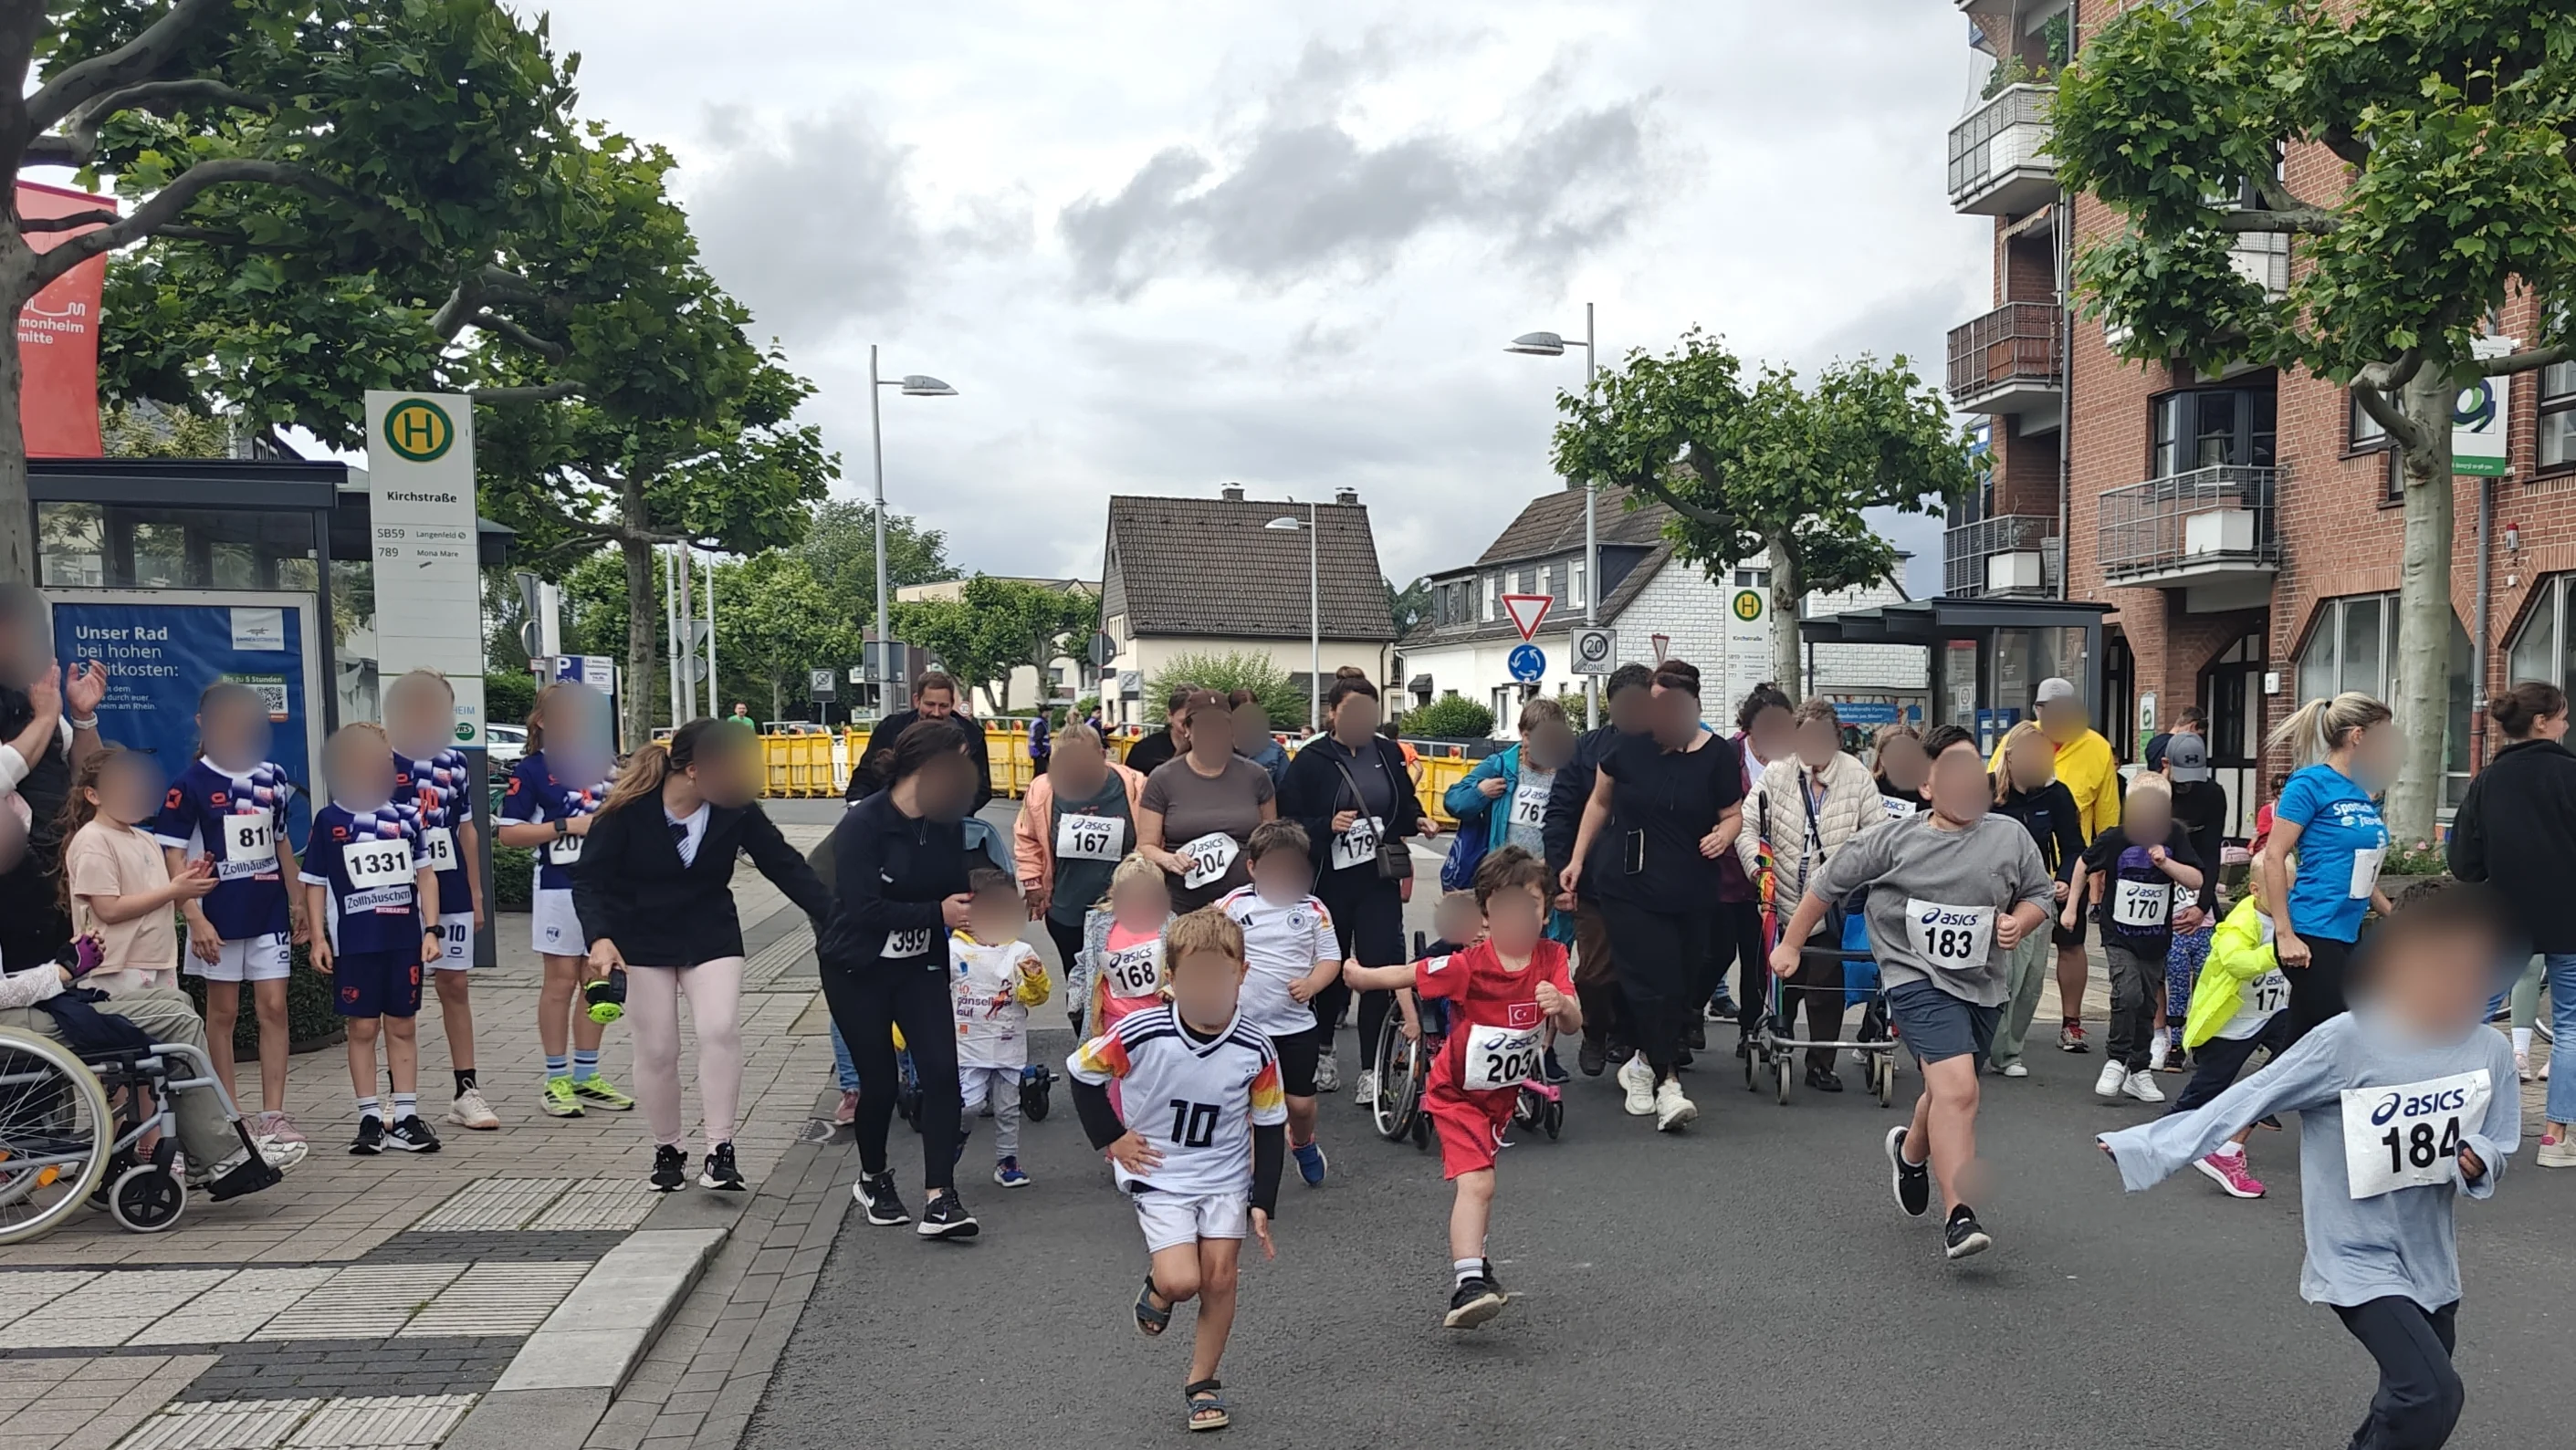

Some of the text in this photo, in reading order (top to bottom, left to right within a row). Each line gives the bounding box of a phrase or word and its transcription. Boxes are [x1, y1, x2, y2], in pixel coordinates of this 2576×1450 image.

[18, 318, 85, 334] monheim
[17, 330, 54, 345] mitte
[403, 412, 434, 449] H
[387, 491, 457, 504] Kirchstraße
[377, 528, 456, 540] SB59 Langenfeld
[378, 548, 459, 558] 789 Mona Mare
[76, 625, 168, 641] Unser Rad
[77, 643, 162, 658] bei hohen
[1586, 640, 1603, 653] 20
[79, 662, 179, 677] Sitkosten:
[556, 657, 571, 675] P
[1583, 663, 1606, 673] ZONE
[223, 675, 234, 683] Bis
[252, 675, 282, 684] Stunden
[107, 694, 129, 702] durch
[1084, 821, 1112, 832] asics
[239, 825, 272, 848] 811
[1074, 832, 1109, 853] 167
[1198, 838, 1223, 852] asics
[1345, 834, 1374, 859] 179
[351, 851, 406, 876] 1331
[1194, 850, 1225, 879] 204
[347, 890, 411, 910] Zollhäuschen
[2139, 889, 2163, 898] asics
[2128, 899, 2159, 919] 170
[1940, 913, 1979, 926] asics
[449, 924, 466, 942] 10
[892, 928, 927, 952] 399
[1924, 927, 1973, 959] 183
[1123, 948, 1152, 965] asics
[1115, 961, 1155, 991] 168
[1486, 1048, 1534, 1083] 203
[2403, 1088, 2465, 1118] asics
[1168, 1099, 1222, 1148] 10
[2382, 1115, 2460, 1174] 184
